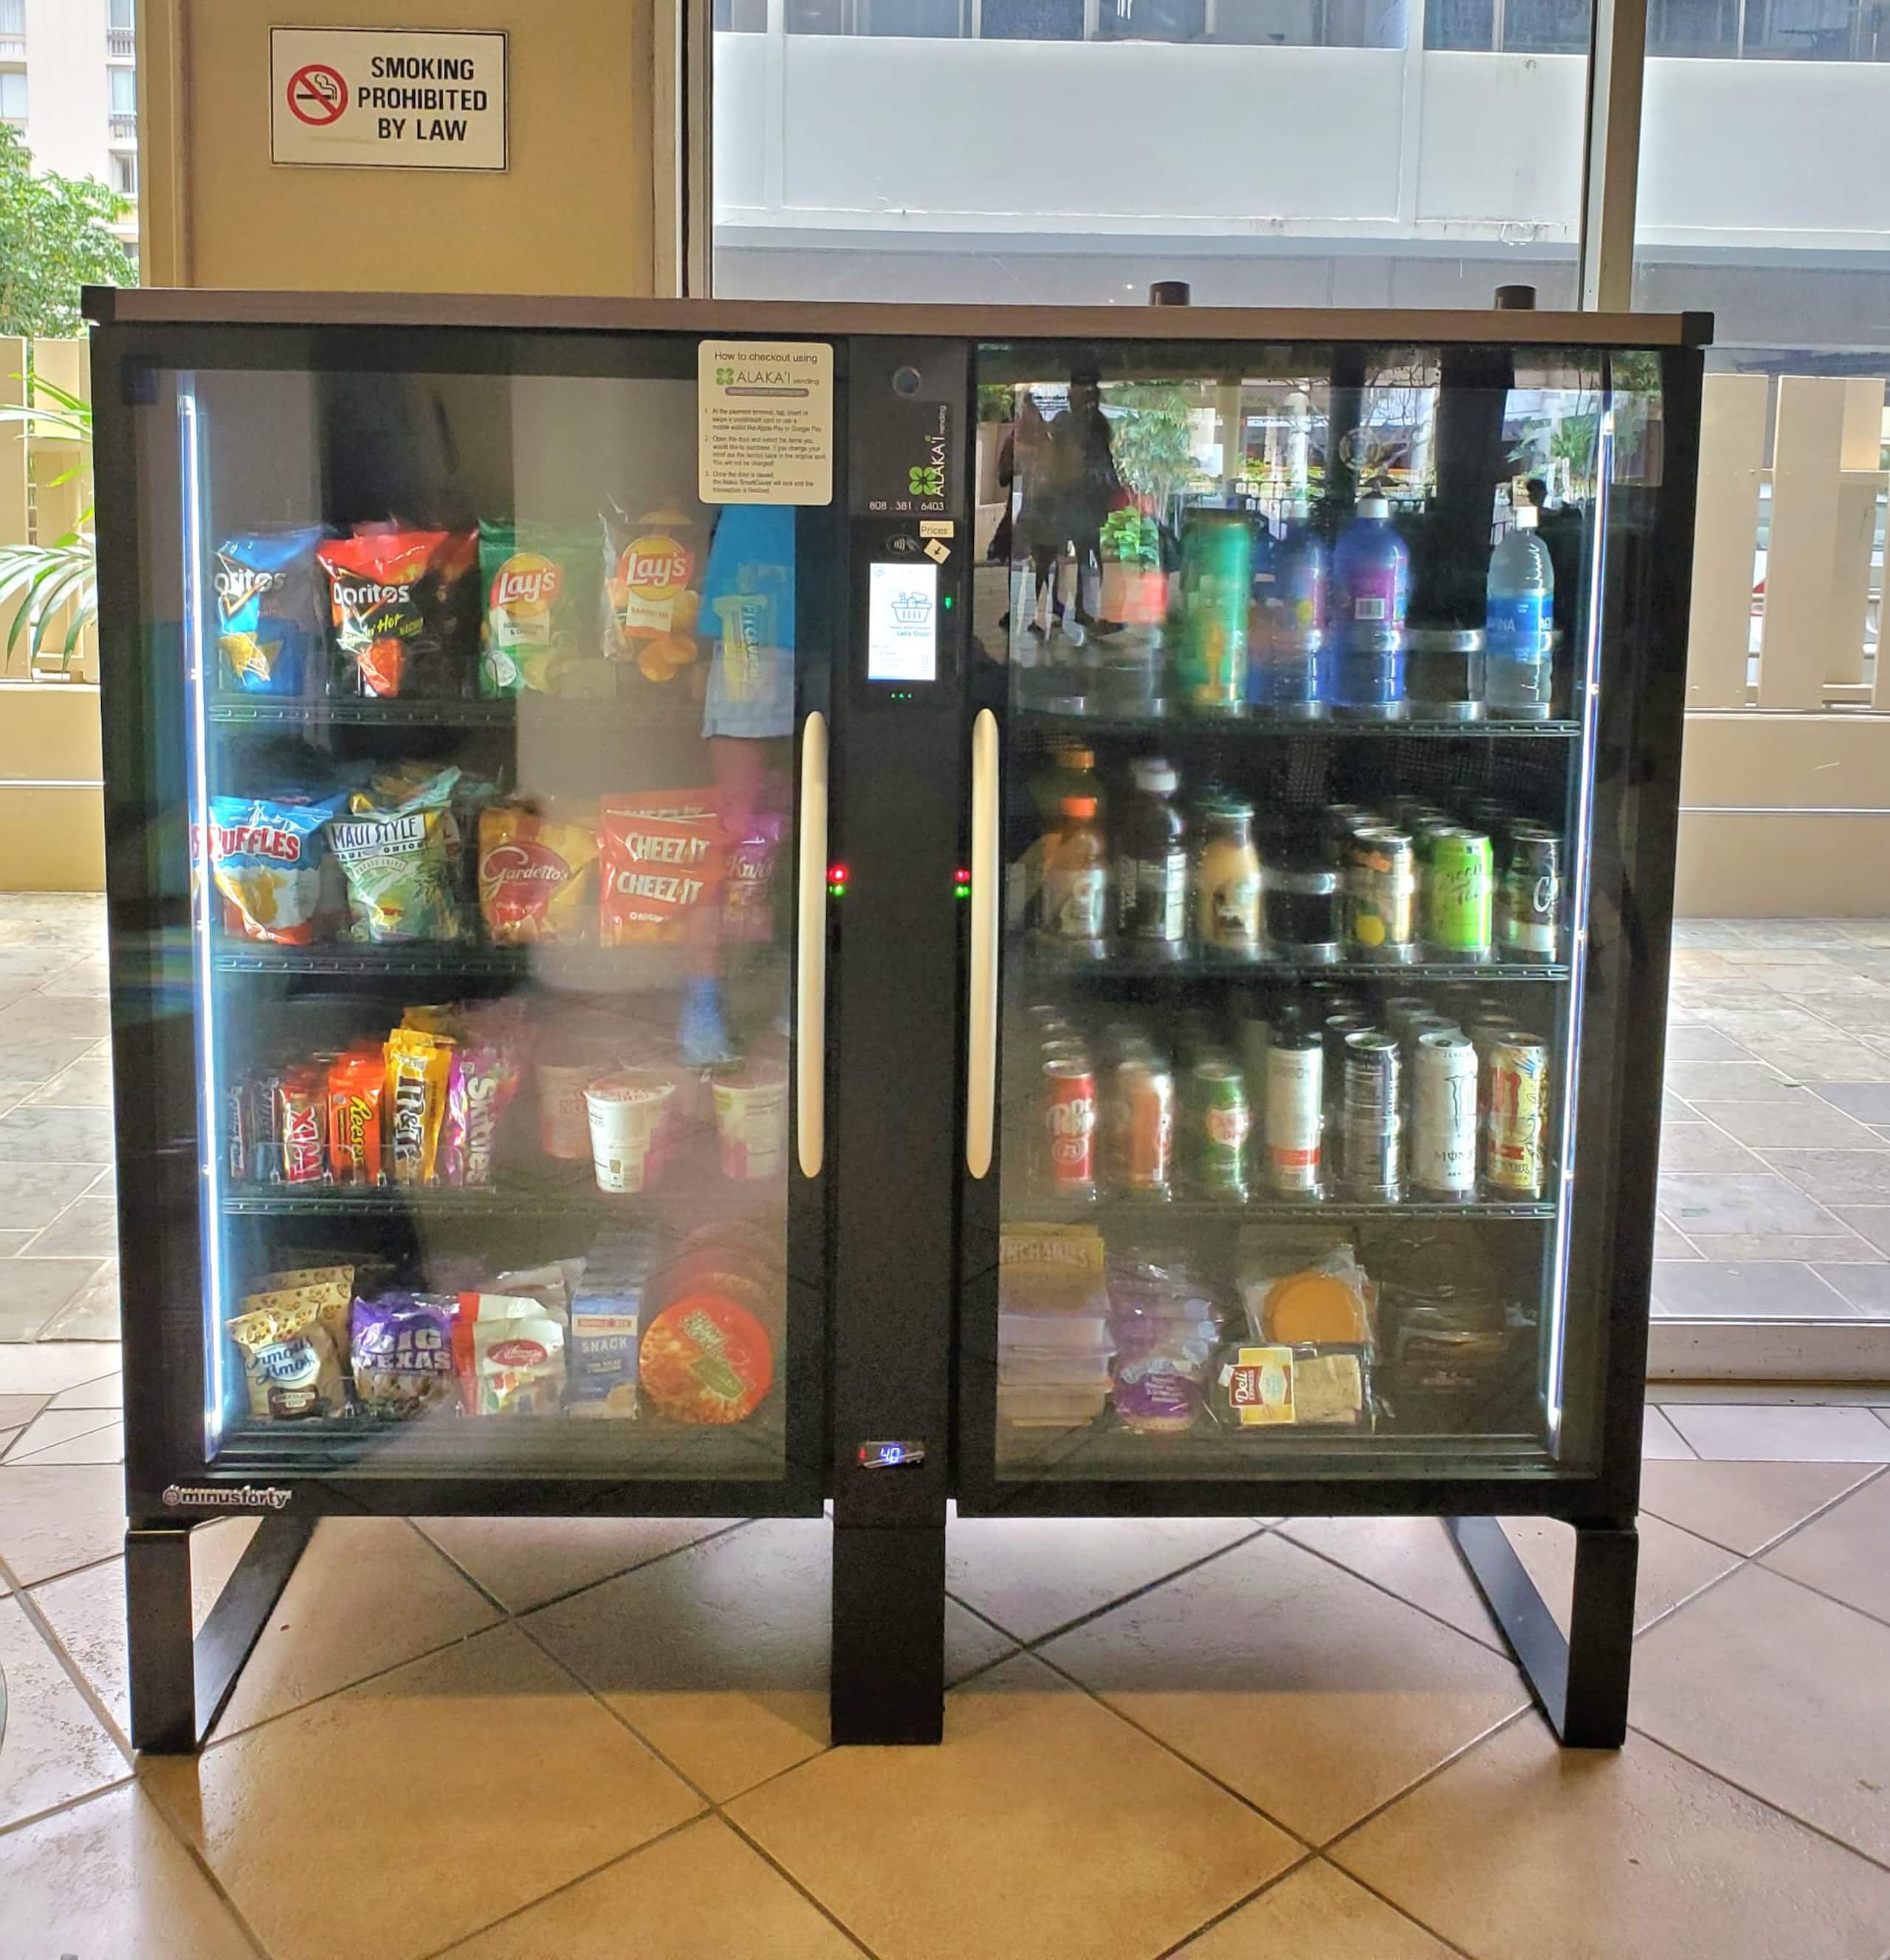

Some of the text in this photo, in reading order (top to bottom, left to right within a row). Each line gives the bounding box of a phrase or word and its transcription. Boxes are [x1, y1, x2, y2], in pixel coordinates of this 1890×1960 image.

[371, 56, 475, 80] SMOKING
[358, 87, 487, 111] PROHIBITED
[378, 117, 467, 141] BY LAW
[714, 351, 817, 365] How to checkout using
[736, 371, 791, 385] ALAKA'I
[869, 501, 945, 511] 808 381 6403
[921, 526, 949, 535] Prices
[213, 568, 289, 594] oritos
[626, 551, 687, 588] Lay's
[334, 583, 410, 604] Doritos
[498, 568, 557, 604] Lay's
[331, 816, 417, 850] MAUI STYLE
[481, 846, 569, 902] Gardetto's
[287, 1107, 323, 1183] TWIX
[581, 1337, 628, 1353] SNACK
[1234, 1370, 1249, 1403] Deli
[182, 1485, 292, 1509] minusforty
